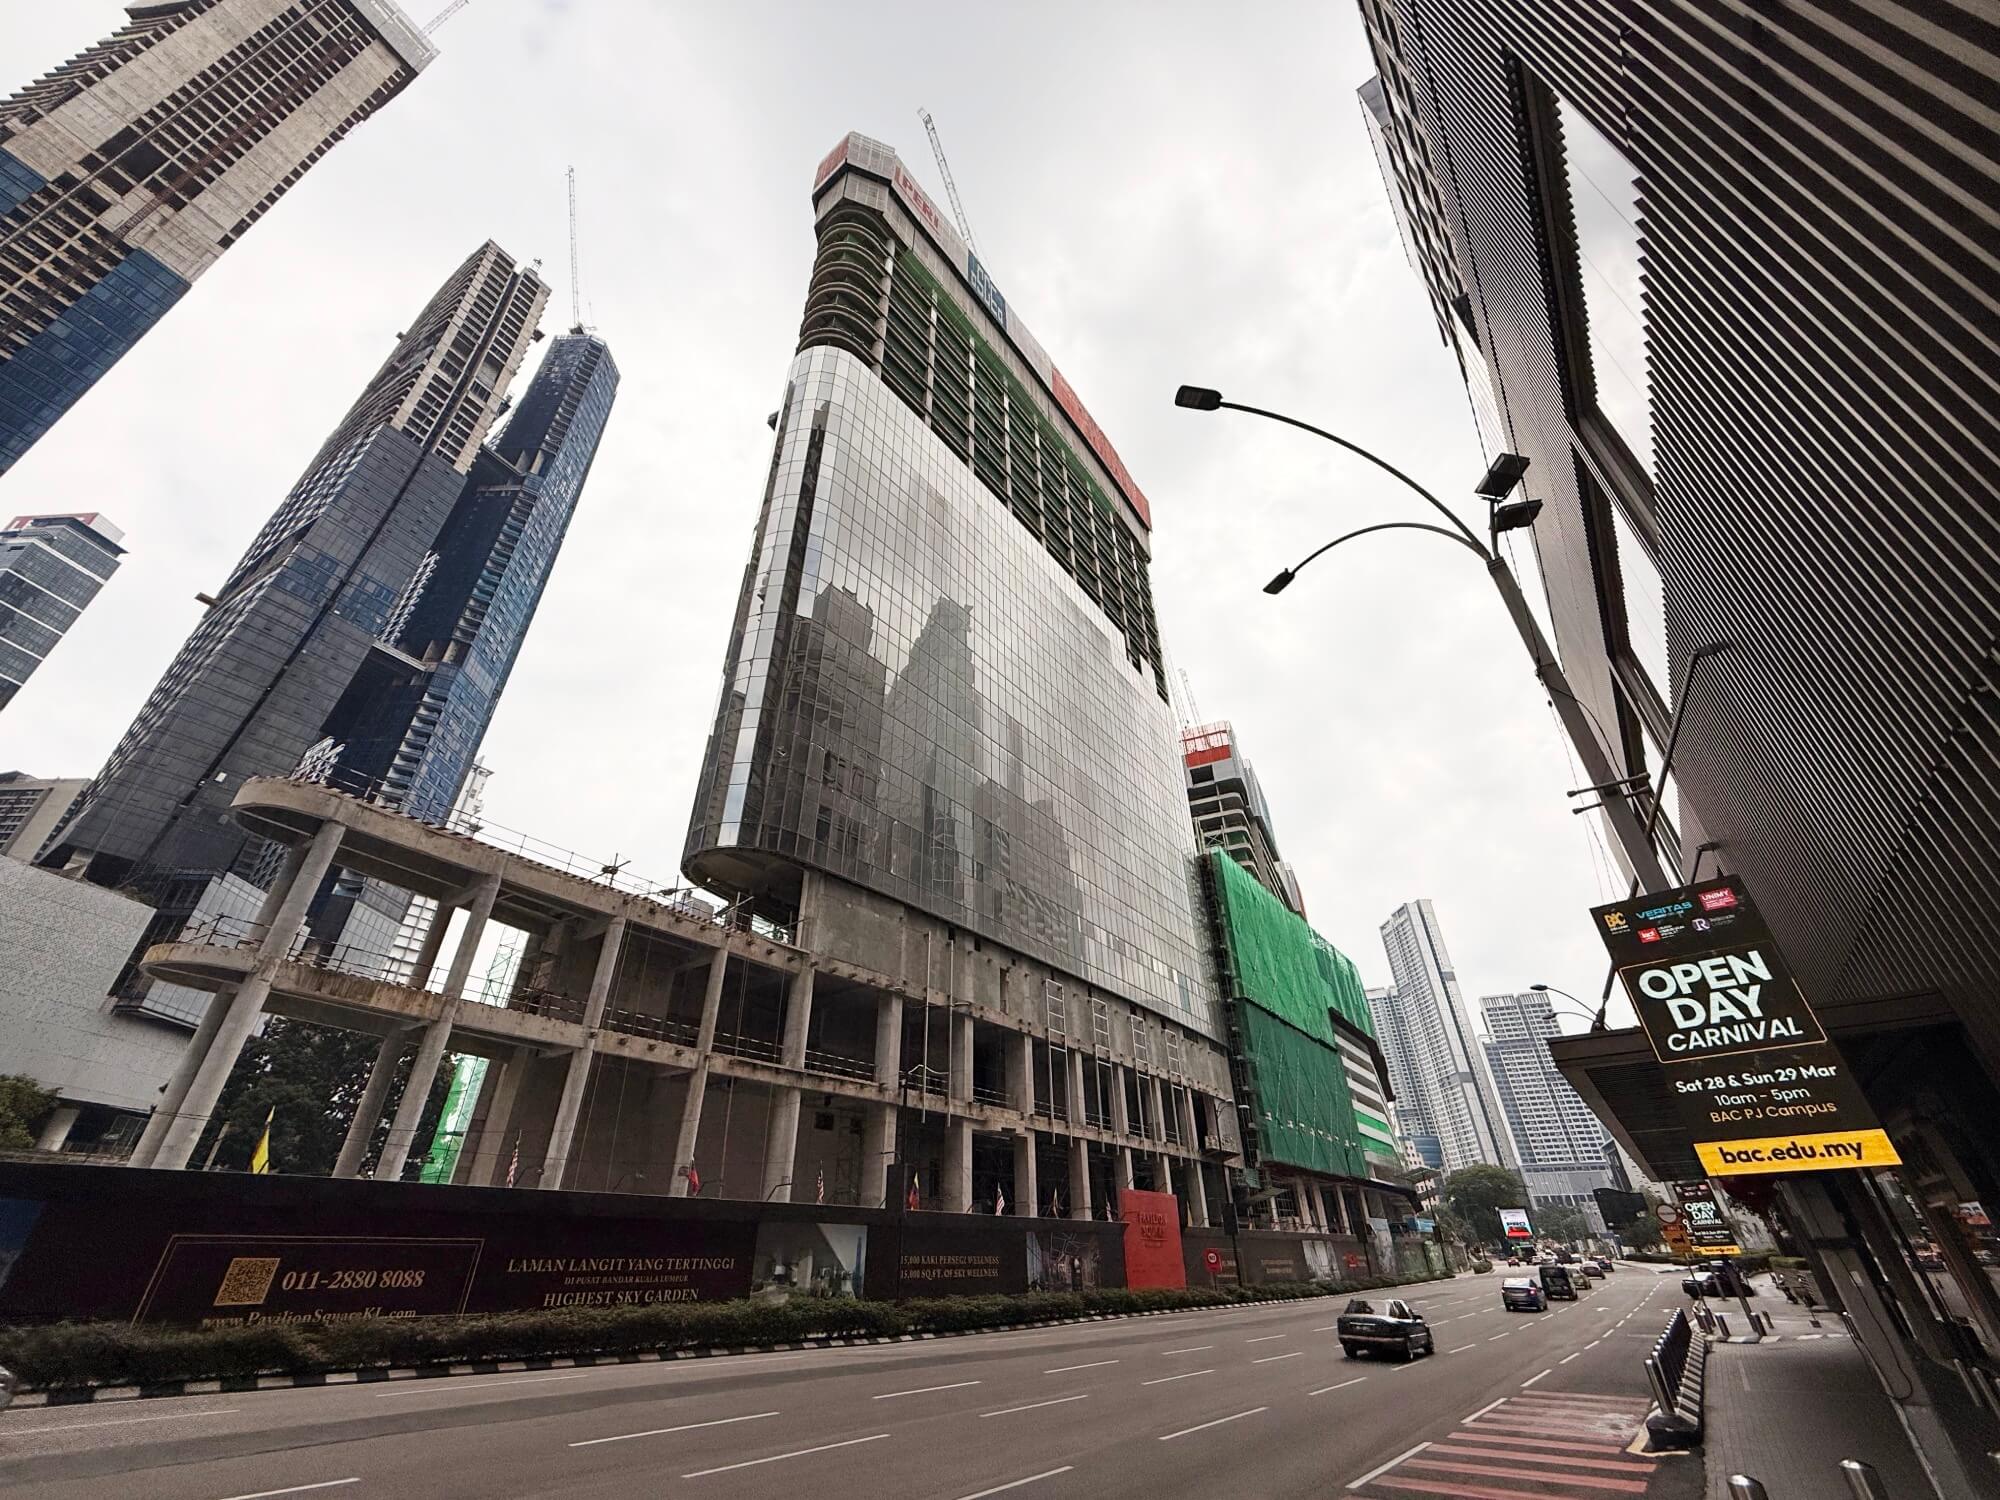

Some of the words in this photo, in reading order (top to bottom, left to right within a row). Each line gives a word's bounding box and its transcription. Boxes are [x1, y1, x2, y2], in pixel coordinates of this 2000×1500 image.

[902, 174, 939, 229] PERI
[1635, 901, 1693, 919] VERITAS
[1638, 950, 1773, 1000] OPEN
[1666, 984, 1763, 1030] DAY
[1667, 1016, 1804, 1051] CARNIVAL
[1675, 1078, 1703, 1093] Sat
[1704, 1076, 1726, 1090] 28
[1727, 1074, 1742, 1087] &
[1742, 1071, 1775, 1086] Sun
[1774, 1068, 1798, 1081] 29
[1799, 1064, 1838, 1080] Mar
[1714, 1092, 1758, 1107] 10am
[1771, 1087, 1812, 1104] 5pm
[1710, 1108, 1743, 1123] BAC
[1744, 1107, 1764, 1119] PJ
[1765, 1101, 1838, 1118] Campus
[1718, 1141, 1863, 1164] bac.edu.my
[1684, 1201, 1716, 1212] OPEN
[1692, 1211, 1714, 1220] DAY
[507, 1258, 566, 1273] LAMAN
[568, 1258, 626, 1272] LANGIT
[628, 1258, 663, 1271] YANG
[666, 1257, 736, 1271] TERTINGGI
[282, 1270, 377, 1290] 011-2880
[379, 1270, 426, 1288] 8088
[564, 1277, 575, 1285] DI
[575, 1276, 601, 1284] PUSAT
[602, 1276, 634, 1284] BANDAR
[635, 1275, 659, 1283] KUALA
[660, 1275, 689, 1283] LUMPUR
[543, 1291, 614, 1307] HIGHEST
[615, 1290, 643, 1304] SKY
[645, 1288, 700, 1303] GARDEN
